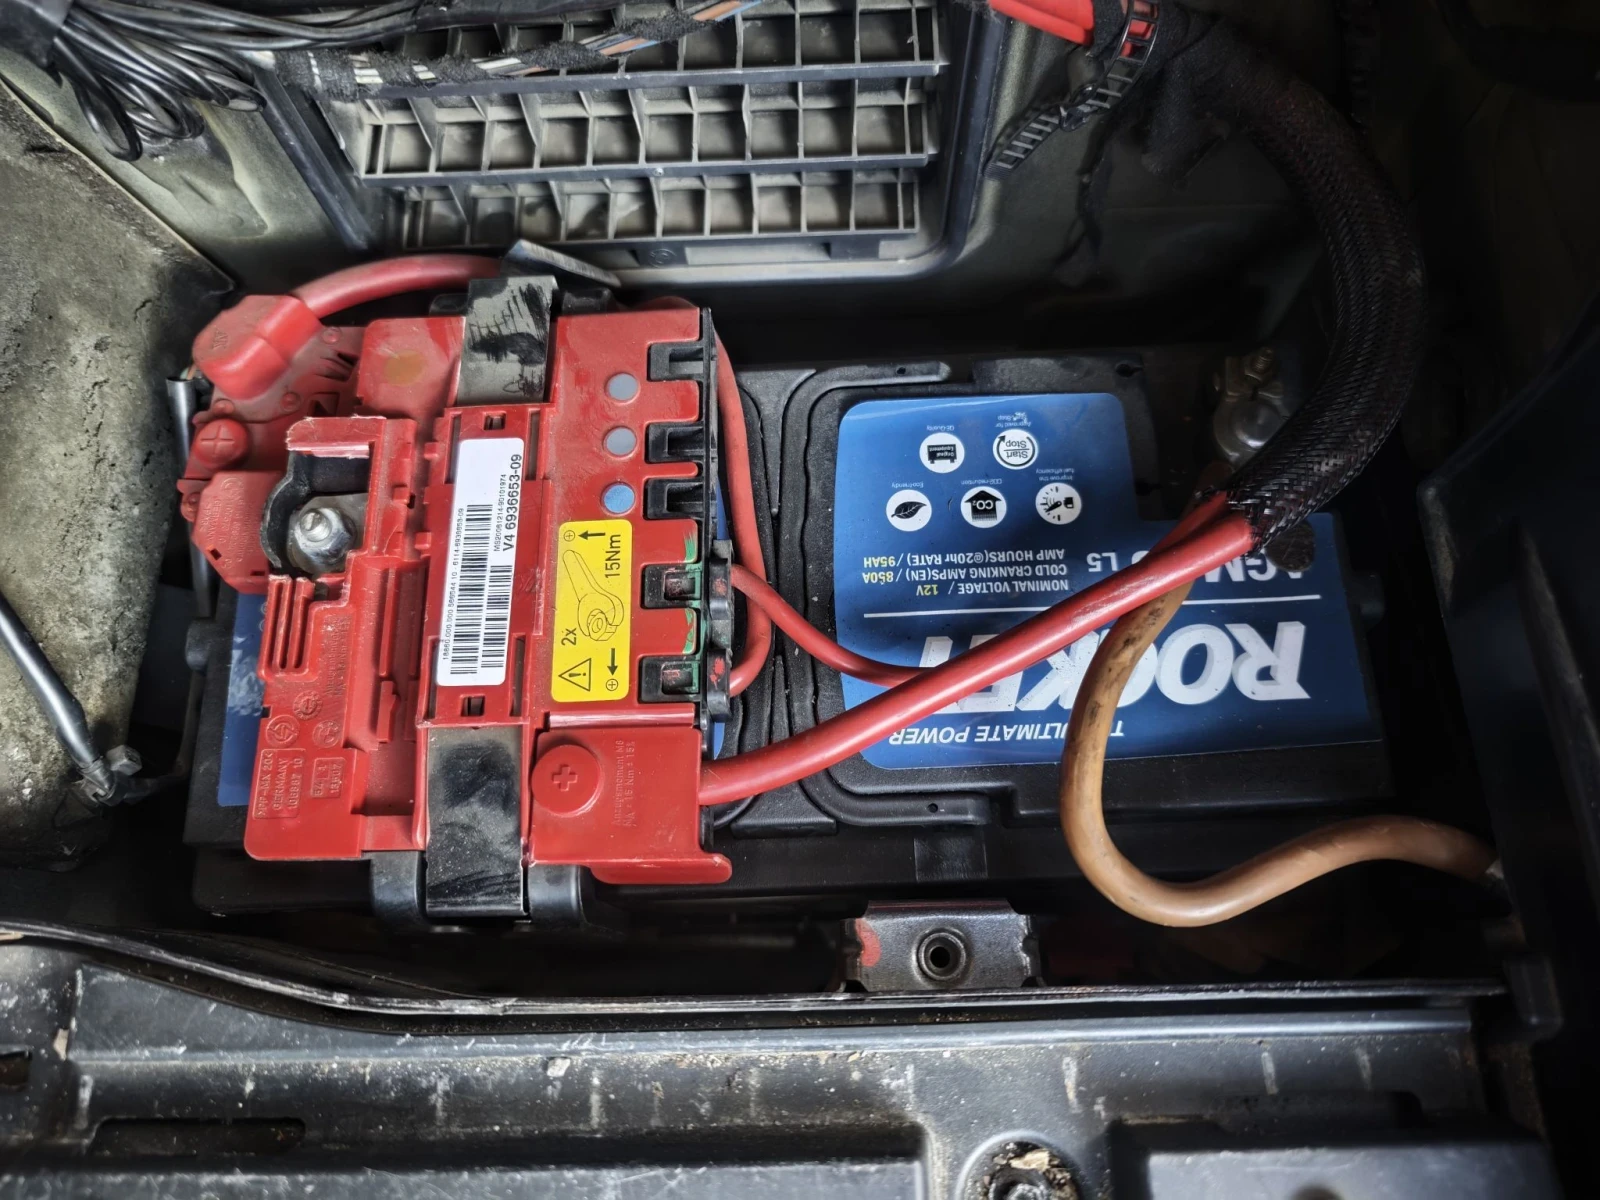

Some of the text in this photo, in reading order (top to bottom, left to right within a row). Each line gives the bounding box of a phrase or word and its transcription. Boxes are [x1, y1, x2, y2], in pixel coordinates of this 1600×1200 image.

[1006, 440, 1027, 449] Stop
[503, 454, 522, 551] V4 6936653-09
[604, 533, 621, 579] 15Nm
[907, 553, 942, 567] RATE)
[945, 550, 1033, 564] HOURS(@20hr
[1036, 548, 1065, 561] AMP
[1086, 552, 1118, 572] L5
[451, 571, 458, 580] 10
[906, 568, 966, 582] AMPS(EN)
[969, 565, 1033, 579] CRANKING
[1035, 564, 1067, 576] COLD
[915, 584, 938, 596] 12V
[957, 581, 1010, 594] VOLTAGE
[1012, 579, 1068, 593] NOMINAL
[560, 627, 577, 646] 2x
[889, 726, 970, 744] POWER
[273, 758, 287, 810] GERMANY
[626, 770, 634, 785] Nm
